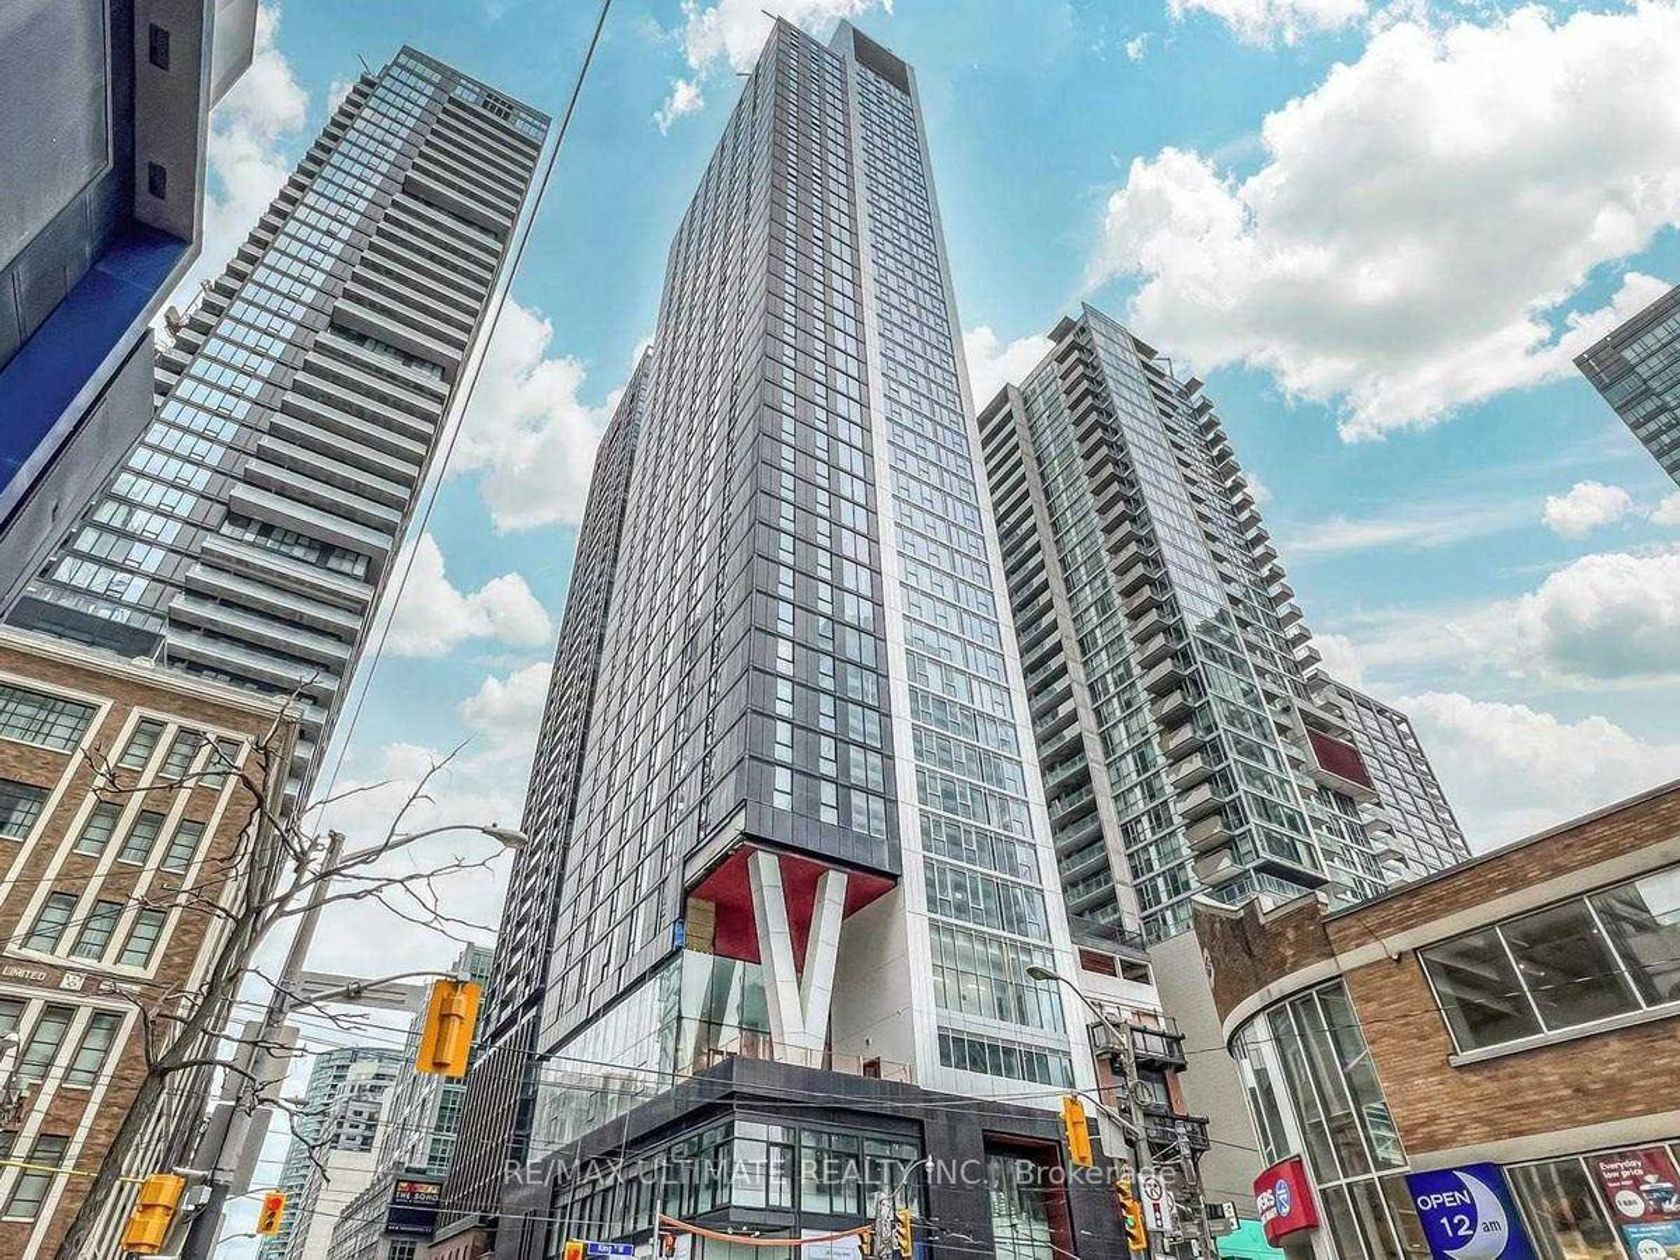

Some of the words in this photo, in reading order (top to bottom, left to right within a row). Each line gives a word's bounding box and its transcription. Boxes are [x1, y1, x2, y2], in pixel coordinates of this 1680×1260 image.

[2, 966, 47, 981] LIMITED
[1599, 1159, 1642, 1170] Everyday
[1417, 1190, 1471, 1210] OPEN
[1440, 1214, 1473, 1237] 12
[1482, 1219, 1502, 1233] am
